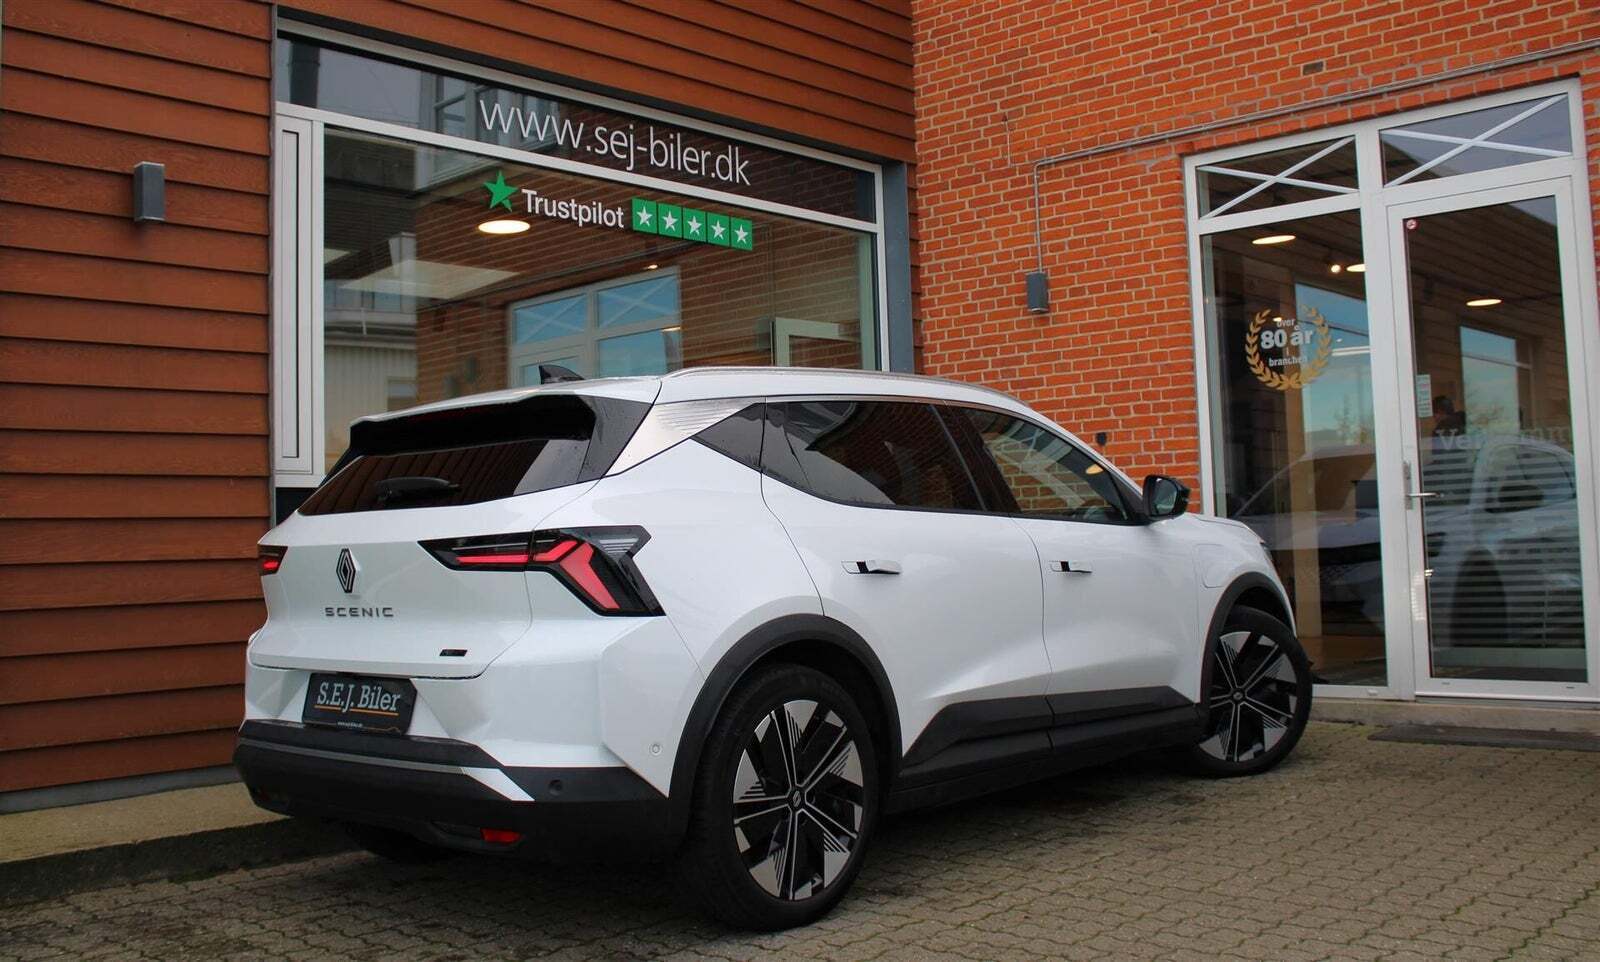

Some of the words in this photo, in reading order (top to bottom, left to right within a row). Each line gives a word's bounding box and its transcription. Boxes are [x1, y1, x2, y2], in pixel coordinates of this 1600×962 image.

[479, 99, 751, 186] www.sej-biler.dk
[521, 188, 625, 228] Trustpilot
[1260, 329, 1287, 349] 80
[1290, 324, 1314, 346] år
[325, 607, 395, 618] SCENIC
[316, 681, 355, 713] S.E.J.
[357, 684, 401, 711] Biler
